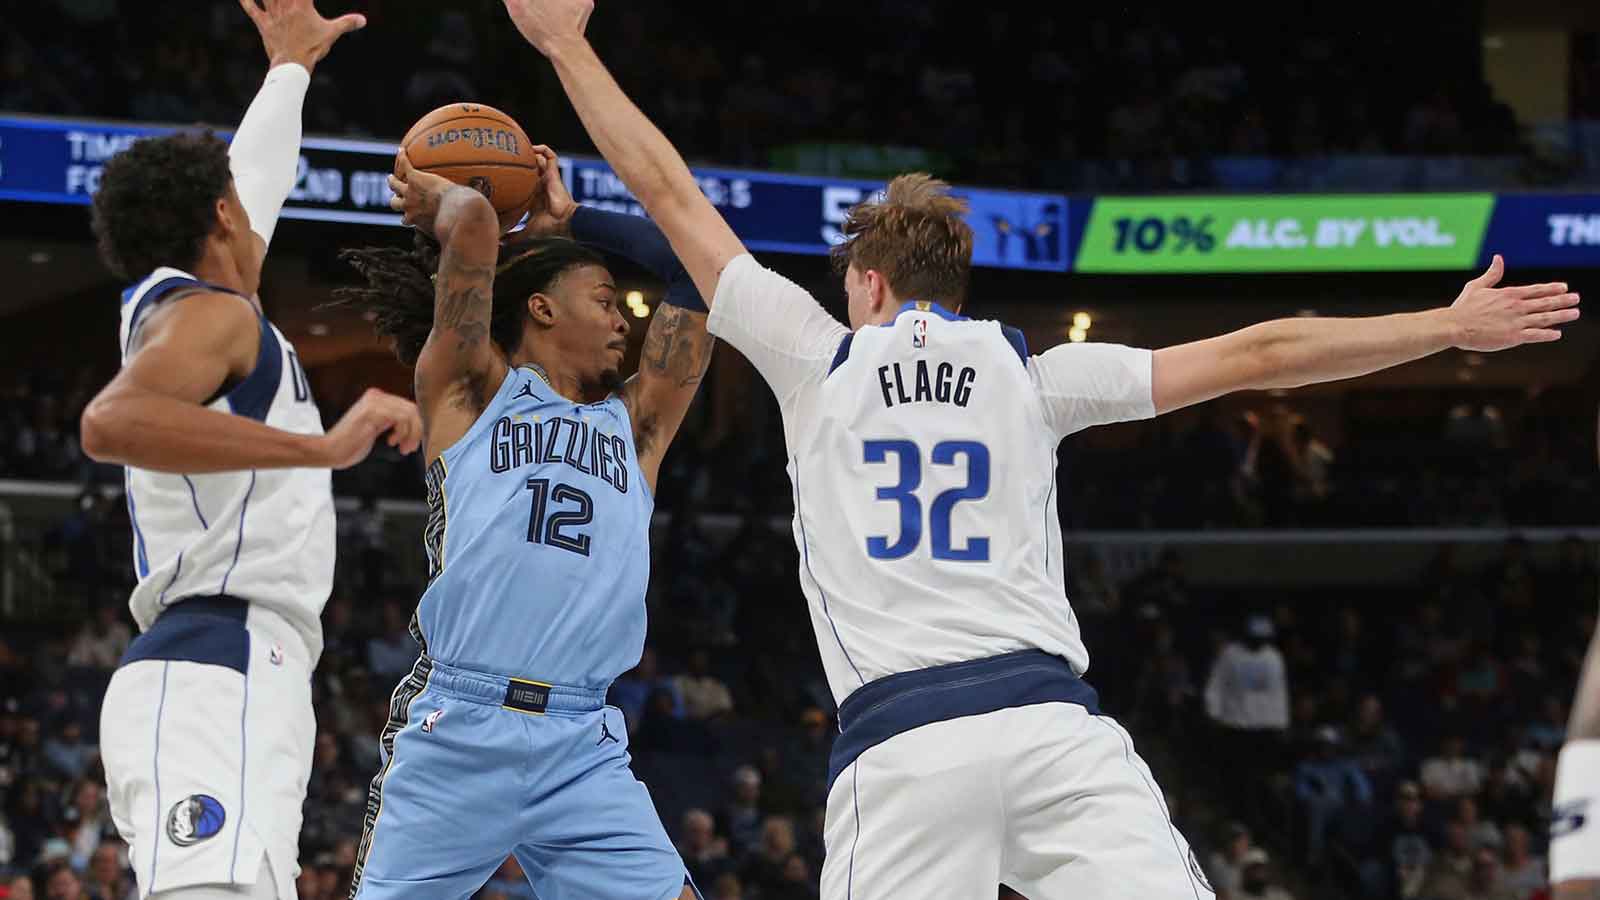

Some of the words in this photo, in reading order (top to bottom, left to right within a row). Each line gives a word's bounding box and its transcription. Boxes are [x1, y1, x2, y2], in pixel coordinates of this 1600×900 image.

[426, 127, 520, 156] Wilson
[1112, 214, 1217, 254] 10%
[1226, 218, 1308, 248] ALC.
[1314, 217, 1366, 248] BY
[1373, 216, 1457, 247] VOL.
[878, 359, 976, 408] FLAGG
[490, 415, 629, 495] GRIZZLIES
[526, 477, 594, 557] 12
[863, 438, 991, 563] 32
